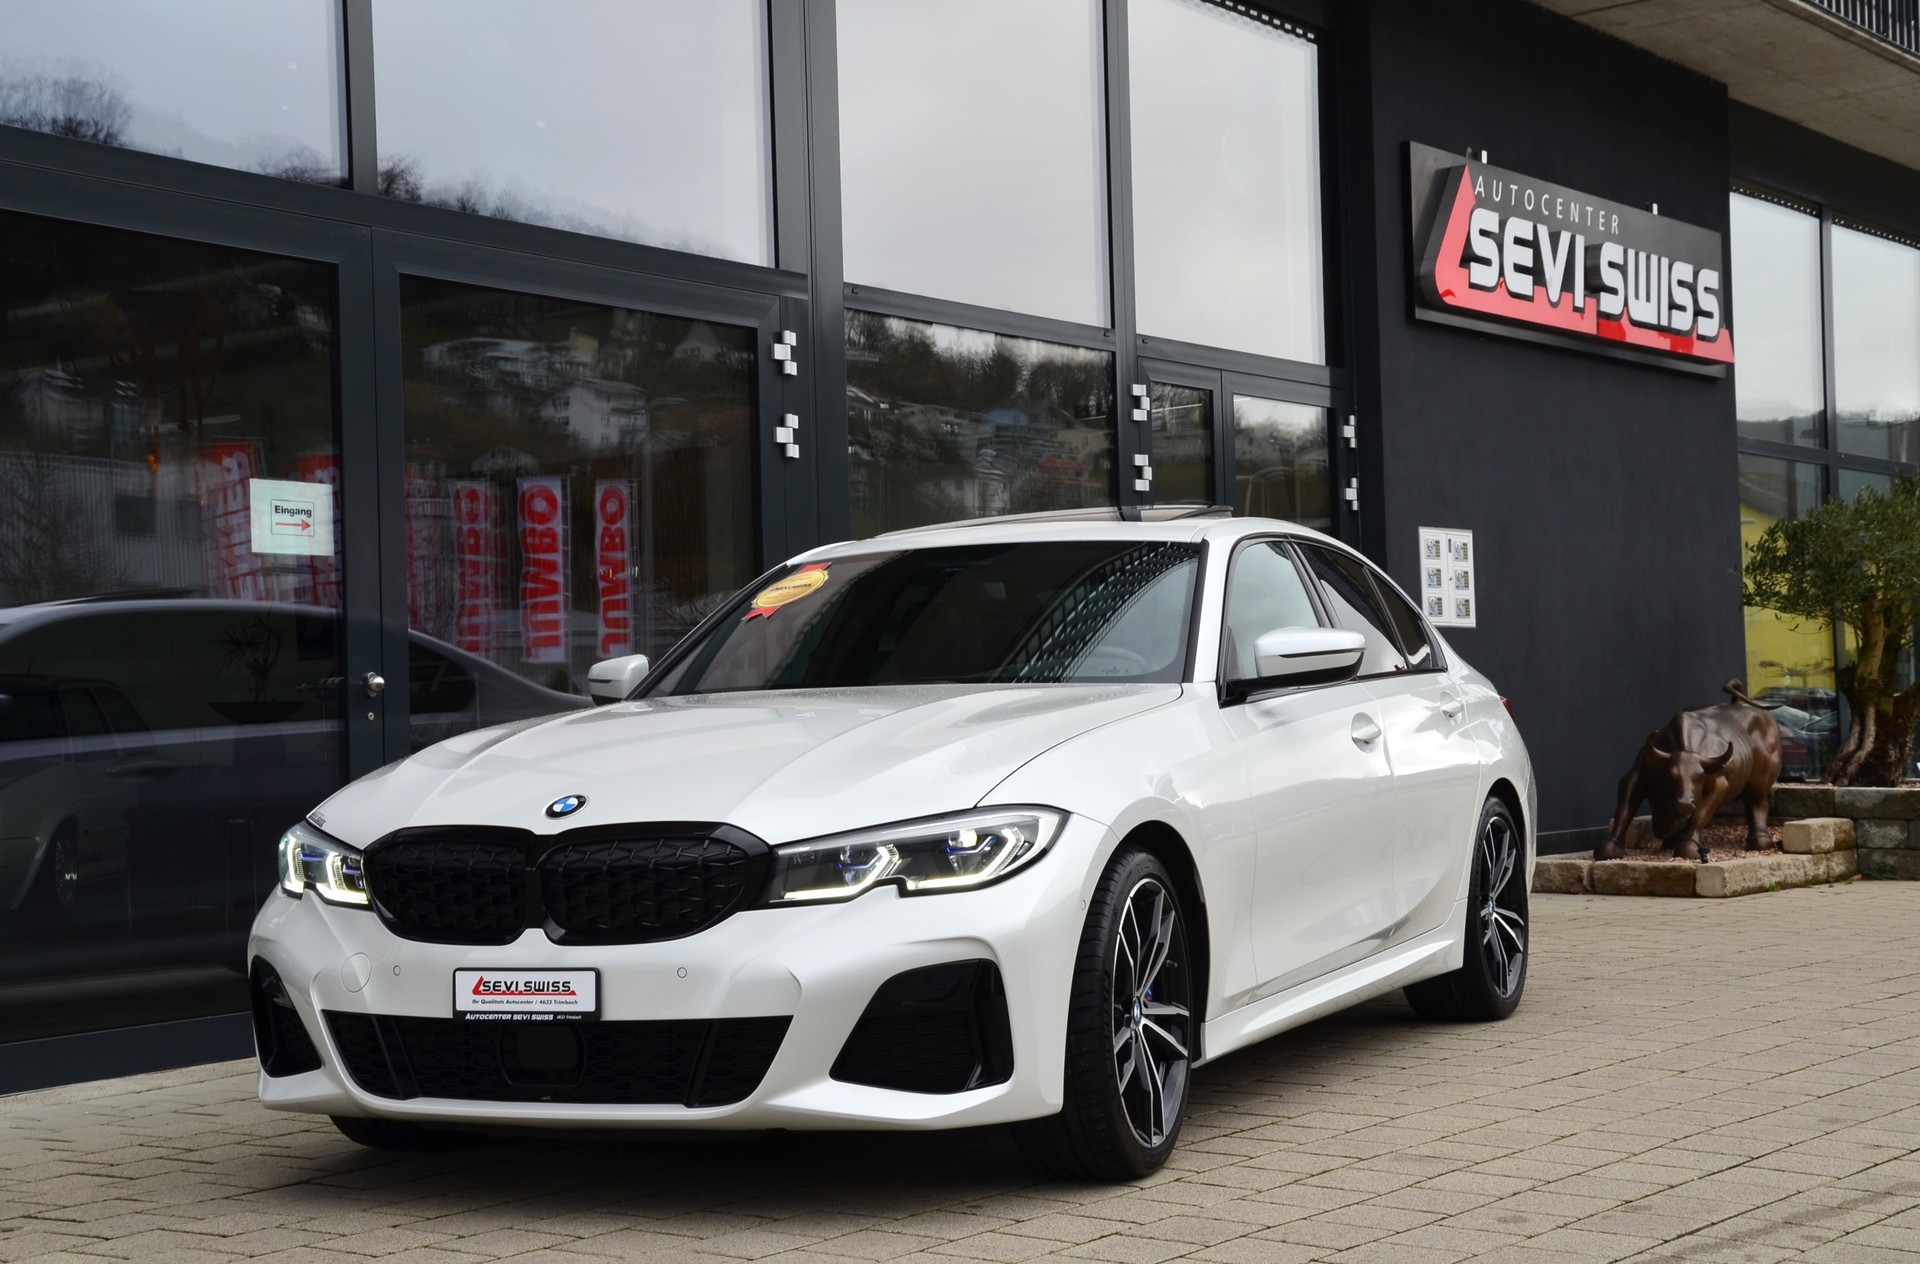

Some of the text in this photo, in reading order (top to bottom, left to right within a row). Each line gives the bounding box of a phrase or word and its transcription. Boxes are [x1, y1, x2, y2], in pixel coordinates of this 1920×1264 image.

[1474, 175, 1620, 235] AUTOCENTER
[1468, 207, 1720, 338] SEVI SWISS
[274, 505, 312, 518] Eingang
[482, 981, 571, 993] SEVI SWISS
